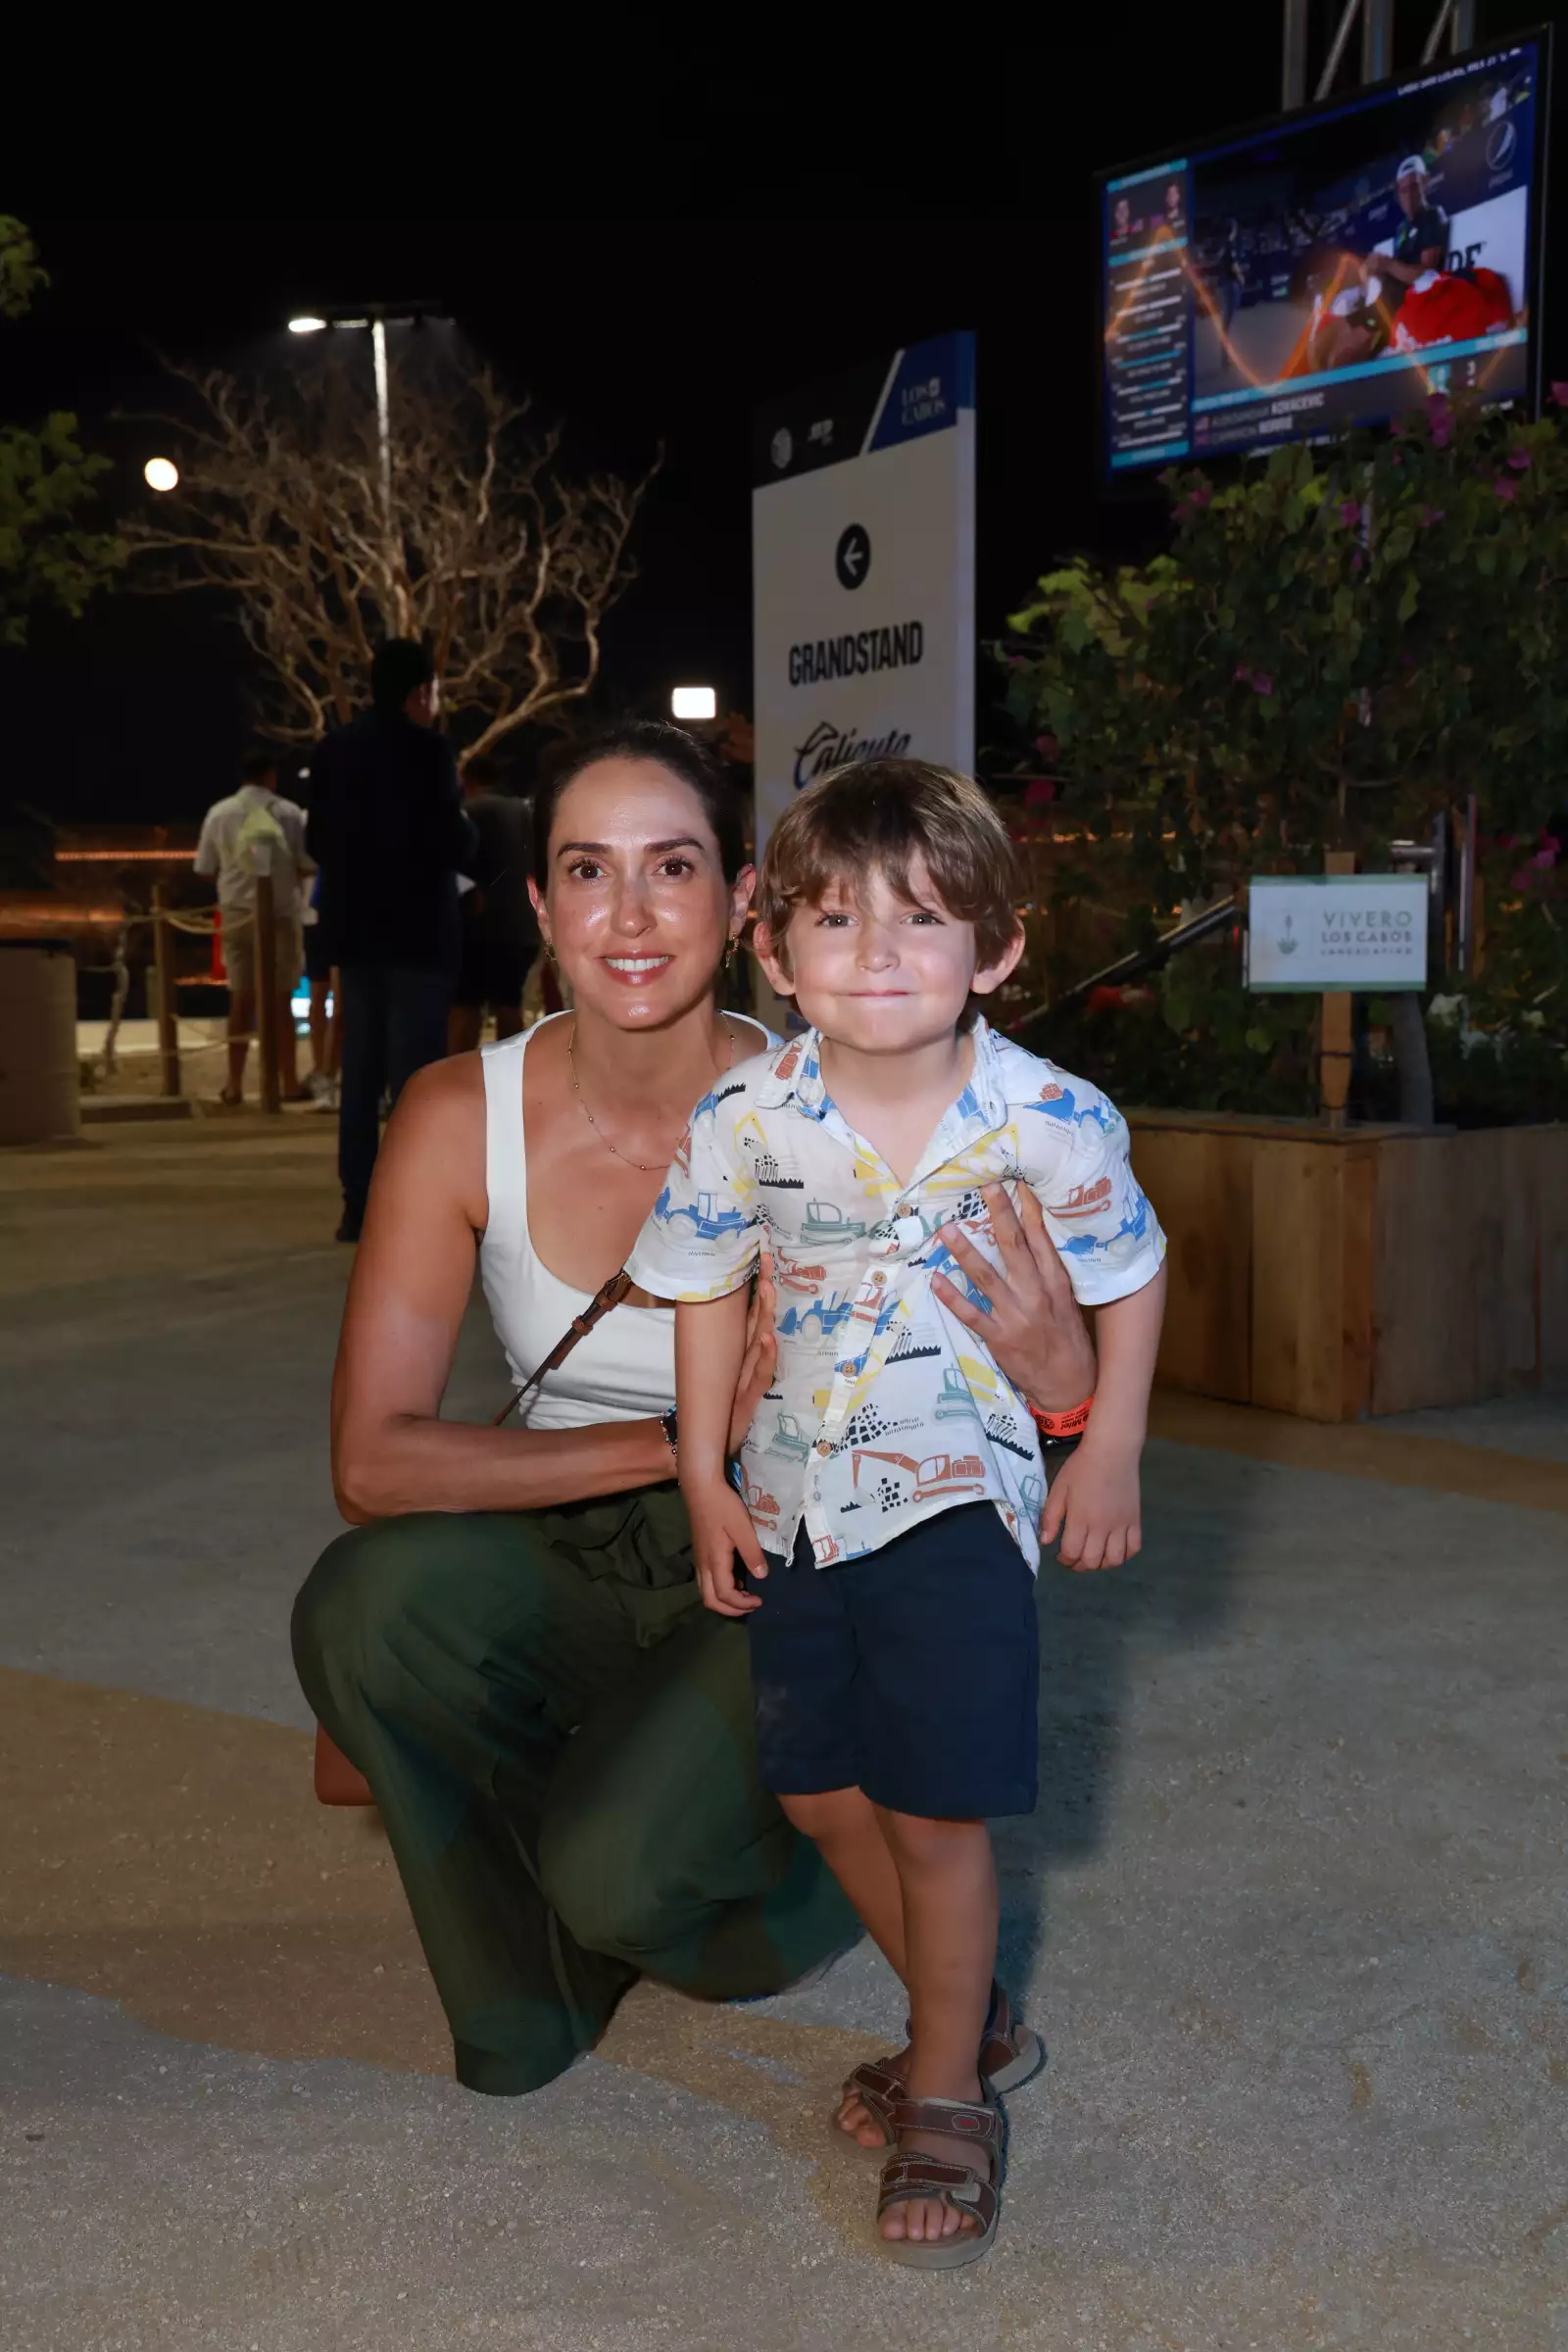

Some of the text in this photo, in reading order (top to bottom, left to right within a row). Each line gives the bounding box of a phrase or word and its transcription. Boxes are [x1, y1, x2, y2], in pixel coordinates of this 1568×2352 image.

[788, 620, 923, 687] GRANDSTAND
[1323, 910, 1412, 928] VIVERO
[1321, 931, 1412, 944] LOS CABOS
